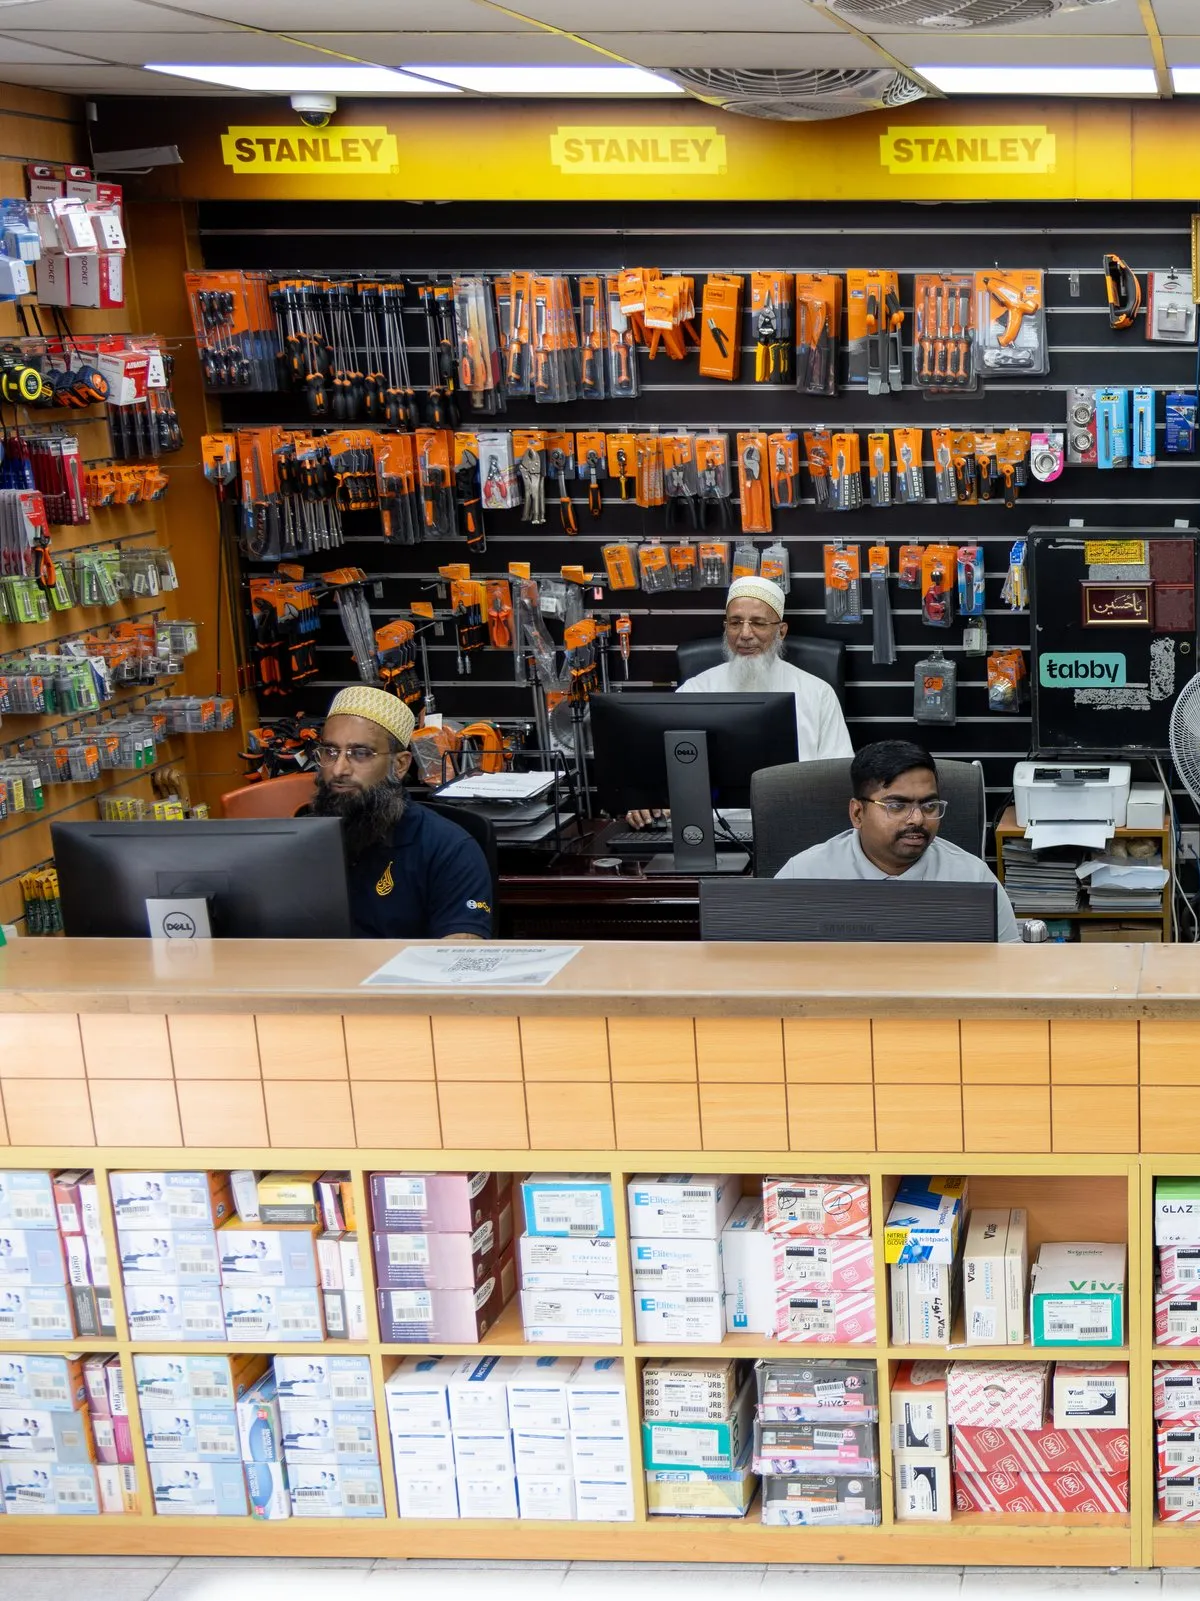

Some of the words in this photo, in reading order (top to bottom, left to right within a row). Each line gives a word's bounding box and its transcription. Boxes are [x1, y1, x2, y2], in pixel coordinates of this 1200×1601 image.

[235, 137, 384, 163] STANLEY
[563, 137, 713, 163] STANLEY
[893, 137, 1043, 163] STANLEY
[1046, 658, 1120, 684] tabby
[677, 748, 696, 757] DELL
[166, 921, 193, 932] DELL
